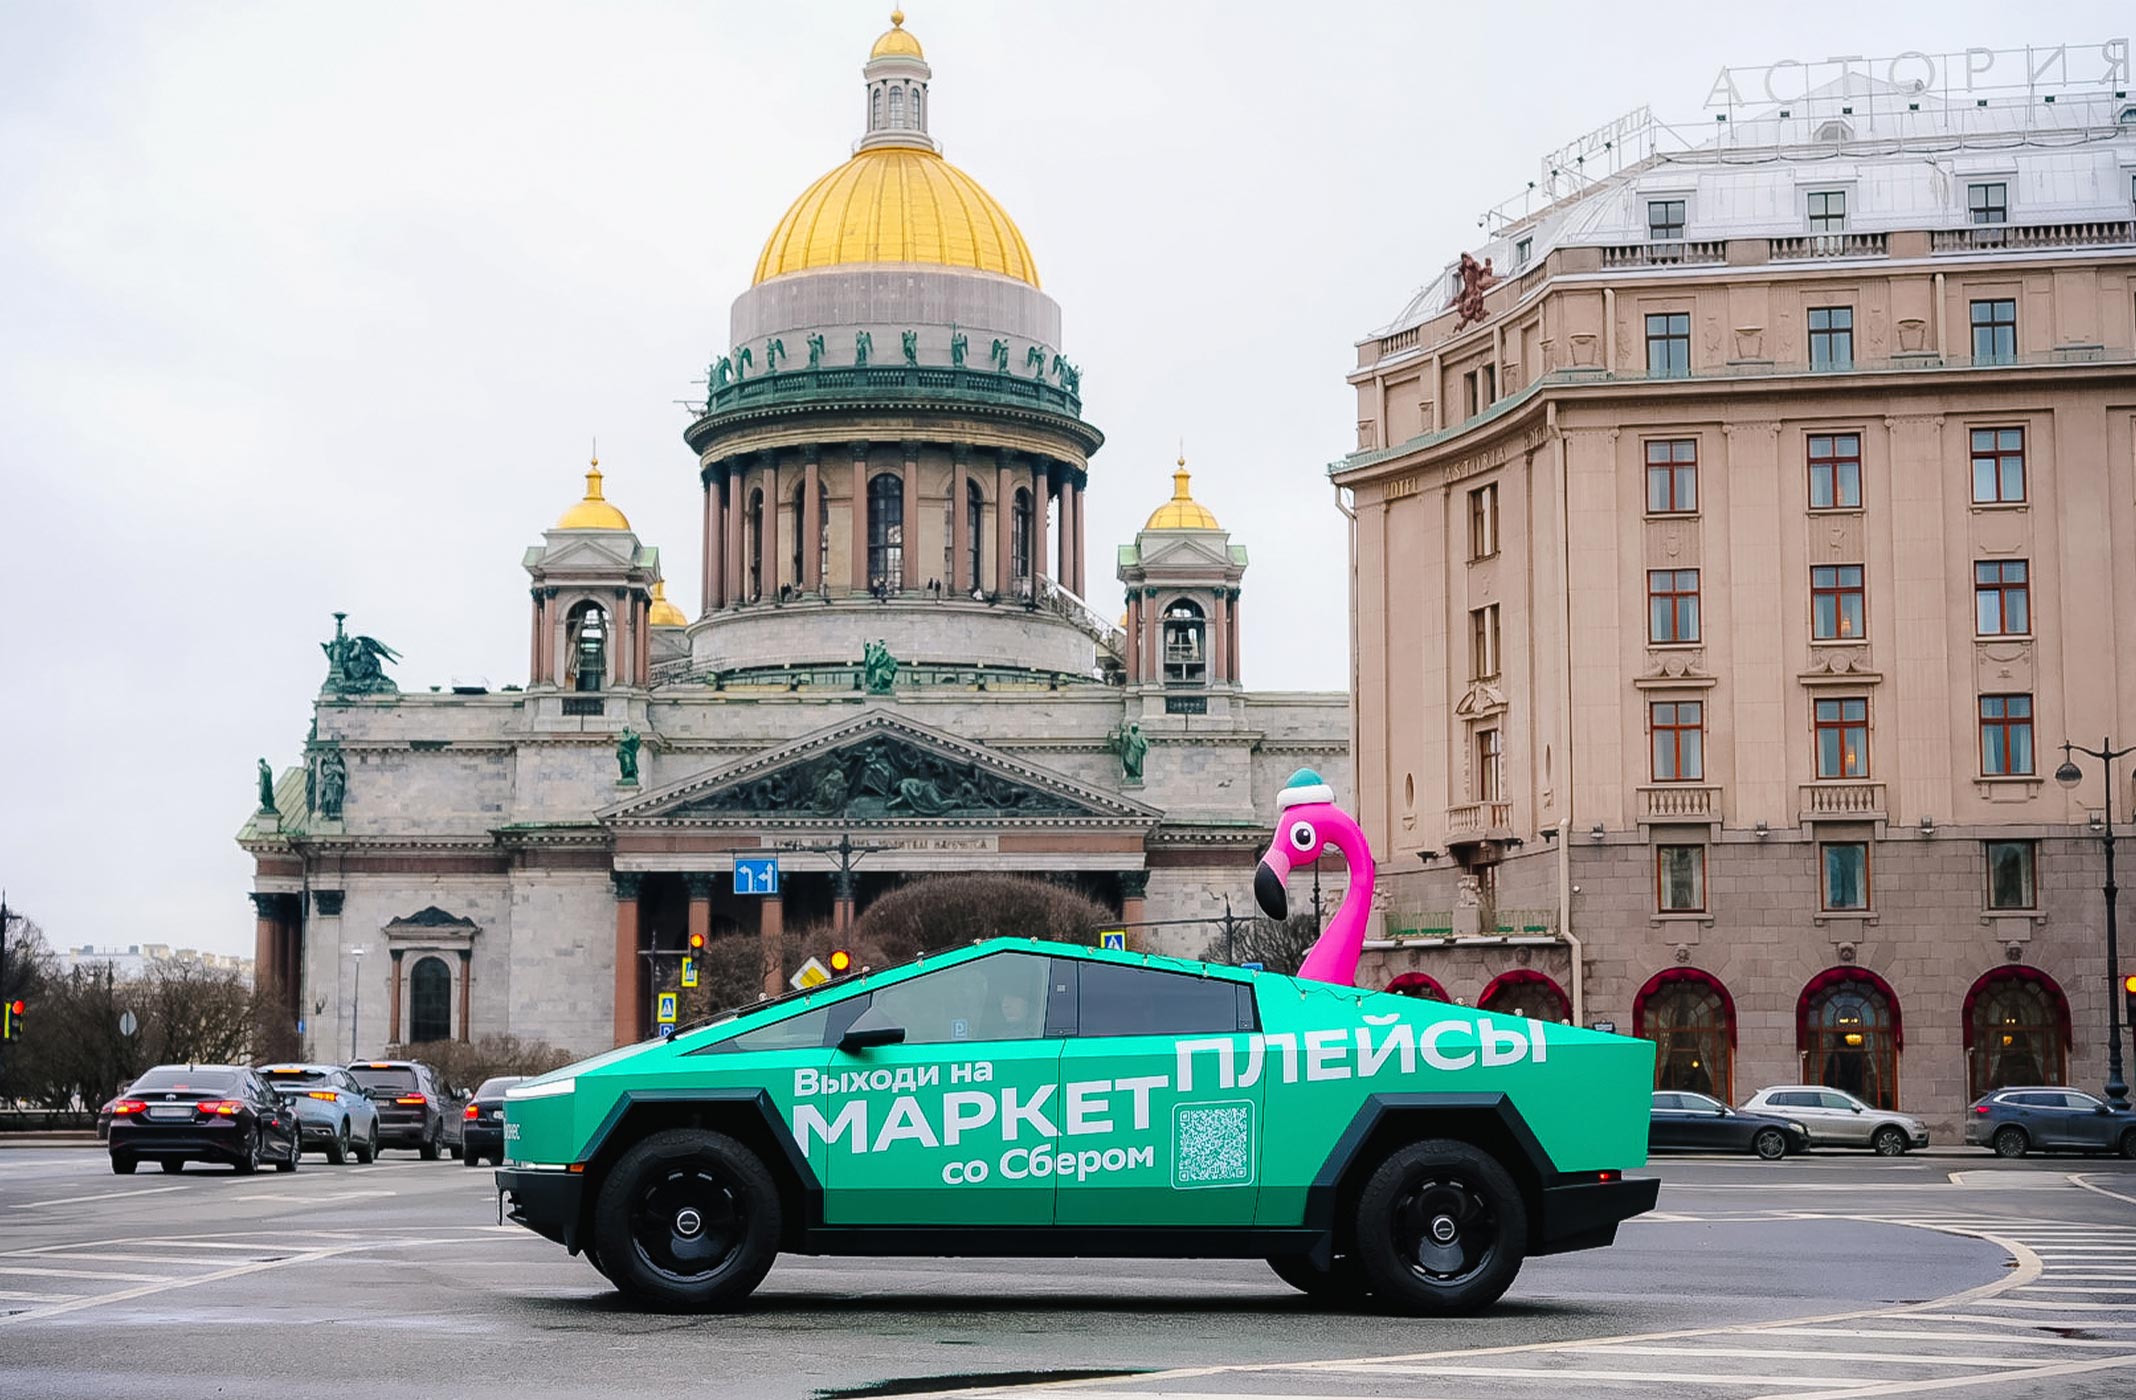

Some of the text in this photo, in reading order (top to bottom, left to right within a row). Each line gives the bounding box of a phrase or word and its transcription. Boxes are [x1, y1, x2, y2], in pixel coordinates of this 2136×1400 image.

[1703, 37, 2130, 110] АСТОРИЯ
[1383, 477, 1418, 499] HOTEL
[1445, 448, 1507, 481] ASTORIA
[793, 1061, 993, 1096] Выходи на
[942, 1143, 1155, 1185] со Сбером
